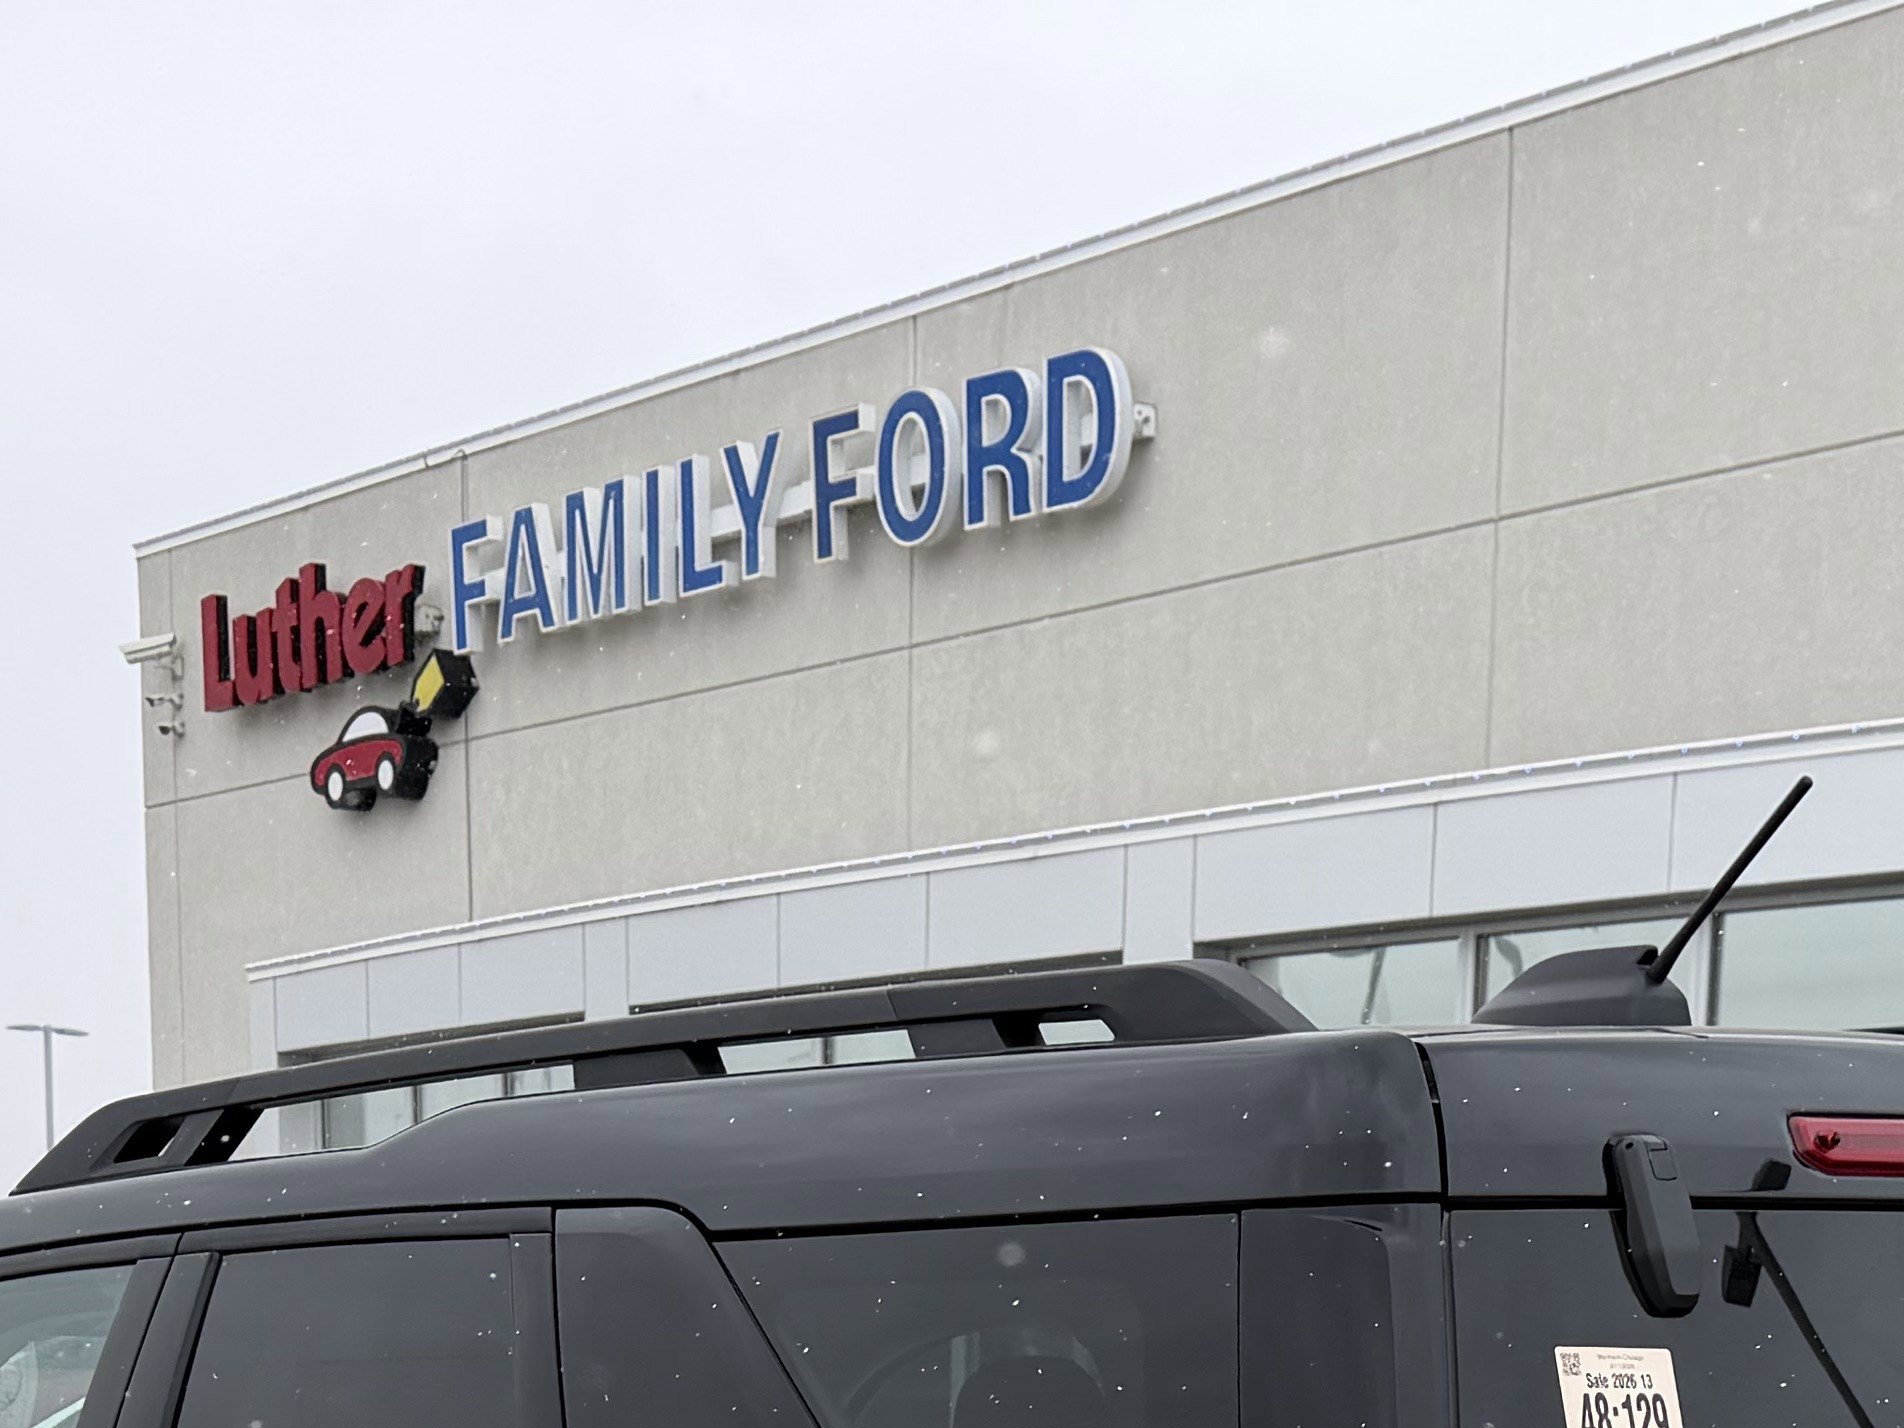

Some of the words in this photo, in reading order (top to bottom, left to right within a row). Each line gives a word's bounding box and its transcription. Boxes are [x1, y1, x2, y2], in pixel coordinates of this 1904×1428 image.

[200, 562, 426, 713] Luther
[449, 430, 784, 657] FAMILY
[811, 345, 1133, 563] FORD
[1585, 1373, 1609, 1389] Sale
[1640, 1373, 1654, 1389] 13
